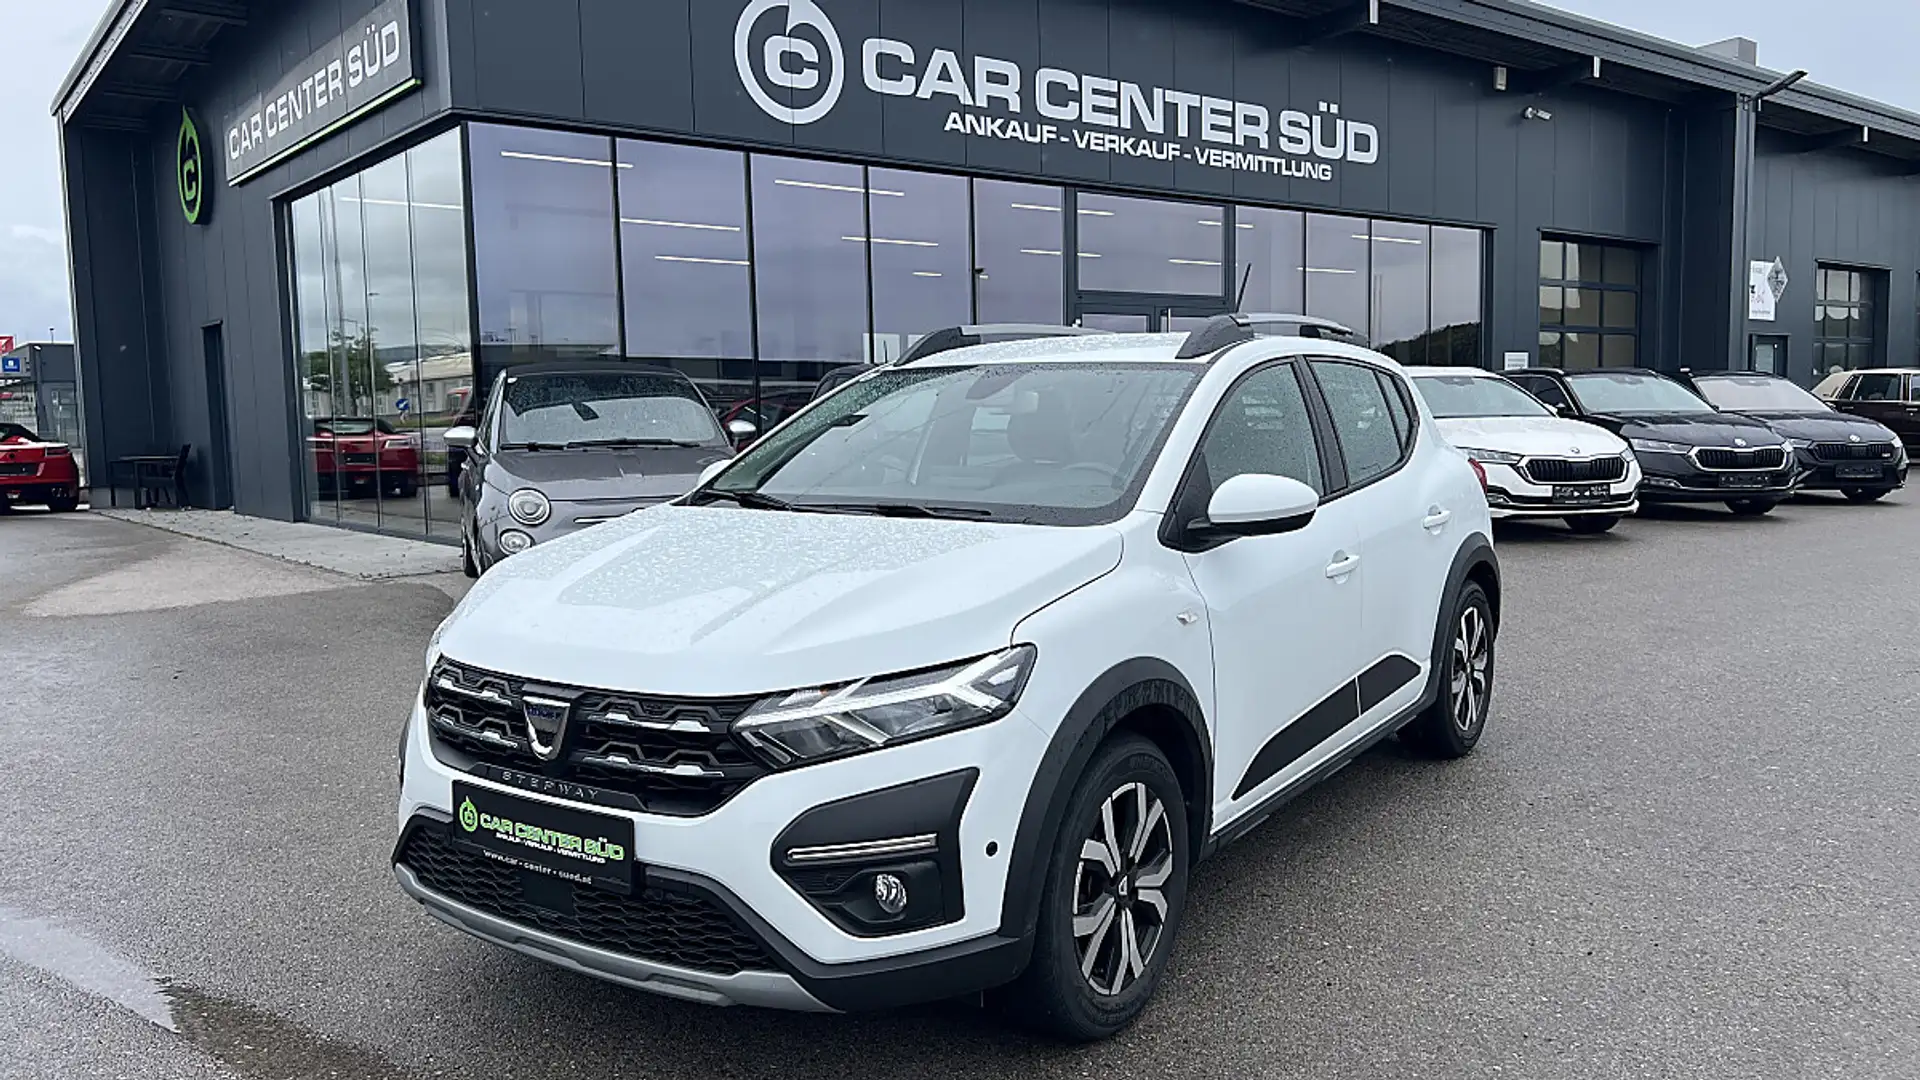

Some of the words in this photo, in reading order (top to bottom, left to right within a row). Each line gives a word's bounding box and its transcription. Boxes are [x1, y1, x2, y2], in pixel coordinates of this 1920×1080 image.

[229, 114, 264, 160] CAR
[265, 58, 343, 138] CENTER
[348, 20, 400, 89] SÜD
[862, 37, 1021, 113] CAR
[1035, 67, 1269, 149] CENTER
[1279, 101, 1379, 164] SÜD
[944, 110, 1057, 145] ANKAUF
[1073, 129, 1181, 161] VERKAUF
[1194, 147, 1333, 182] VERMITTLUNG
[502, 771, 599, 799] STEPWAY
[480, 813, 513, 834] CAR
[515, 822, 582, 851] CENTER
[584, 837, 625, 861] SÜD
